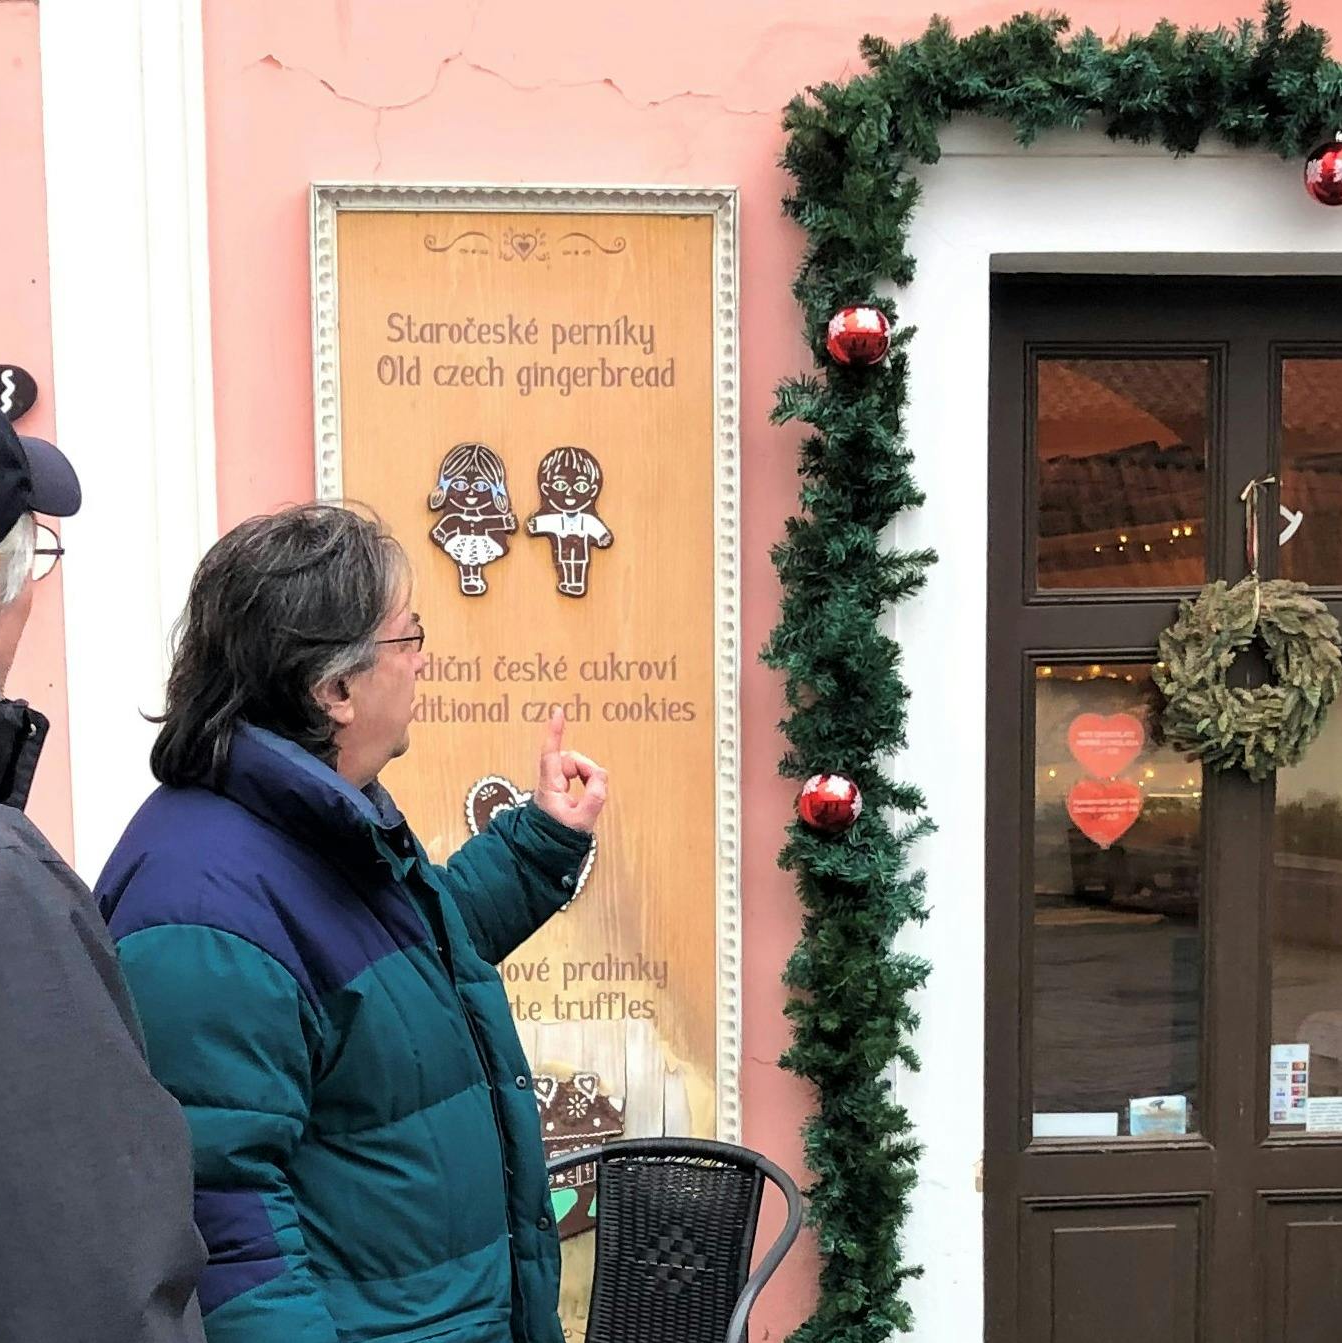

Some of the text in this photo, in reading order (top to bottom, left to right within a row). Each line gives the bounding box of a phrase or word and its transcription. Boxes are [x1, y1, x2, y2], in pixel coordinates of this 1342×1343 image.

[386, 312, 655, 356] Staročeské perníky
[377, 354, 675, 397] Old czech gingerbread
[420, 652, 677, 682] diční české cukroví
[414, 693, 509, 723] ditional
[602, 693, 697, 723] cookies
[562, 953, 668, 991] pralinky
[510, 991, 655, 1022] te truffles
